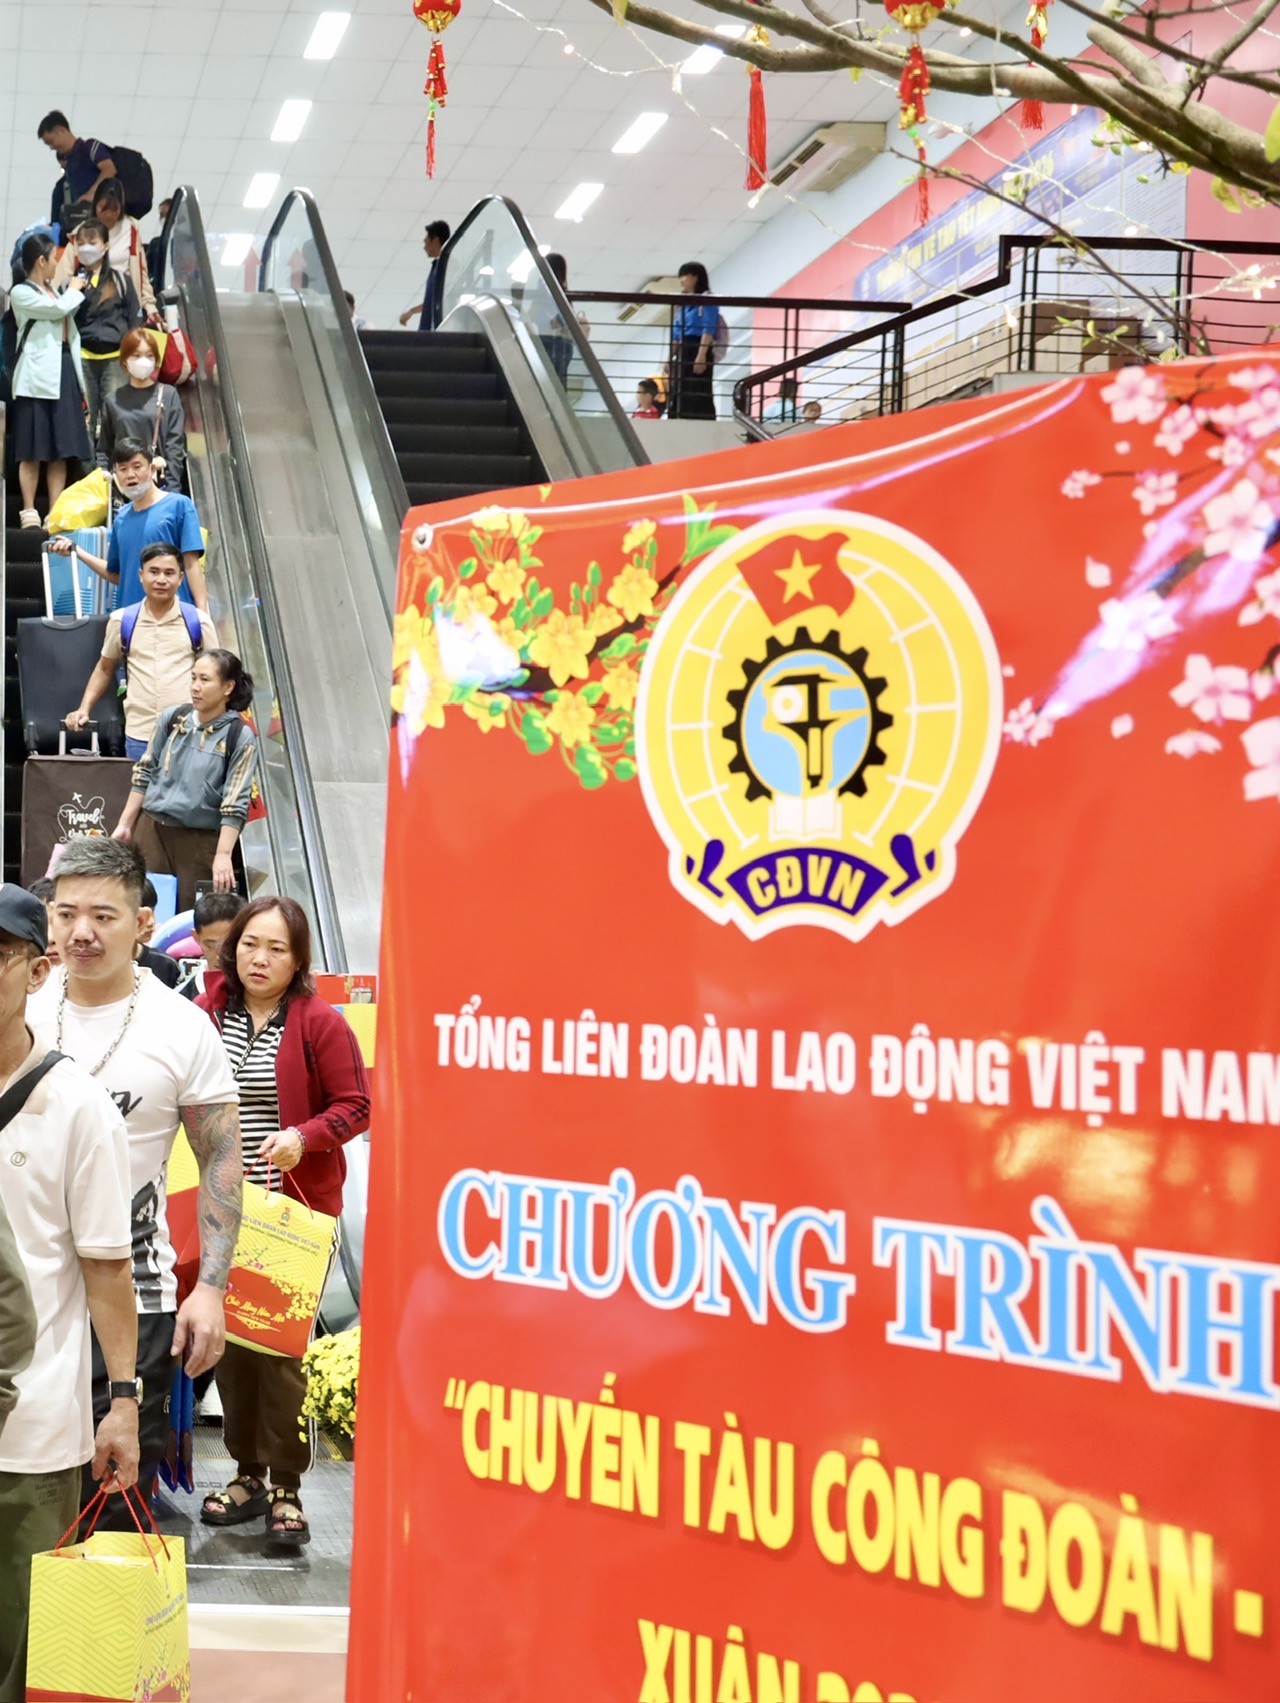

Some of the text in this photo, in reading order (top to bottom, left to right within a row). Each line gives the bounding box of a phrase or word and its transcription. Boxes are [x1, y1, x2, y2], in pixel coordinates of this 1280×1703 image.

[60, 807, 102, 826] Travel
[746, 853, 867, 911] CĐVN
[433, 994, 1280, 1128] TỔNG LIÊN ĐOÀN LAO ĐỘNG VIỆT NAM
[436, 1167, 1280, 1411] CHƯƠNG TRÌNH
[674, 1411, 795, 1550] TÀU
[810, 1437, 985, 1598] CÔNG
[1000, 1486, 1214, 1661] ĐOÀN
